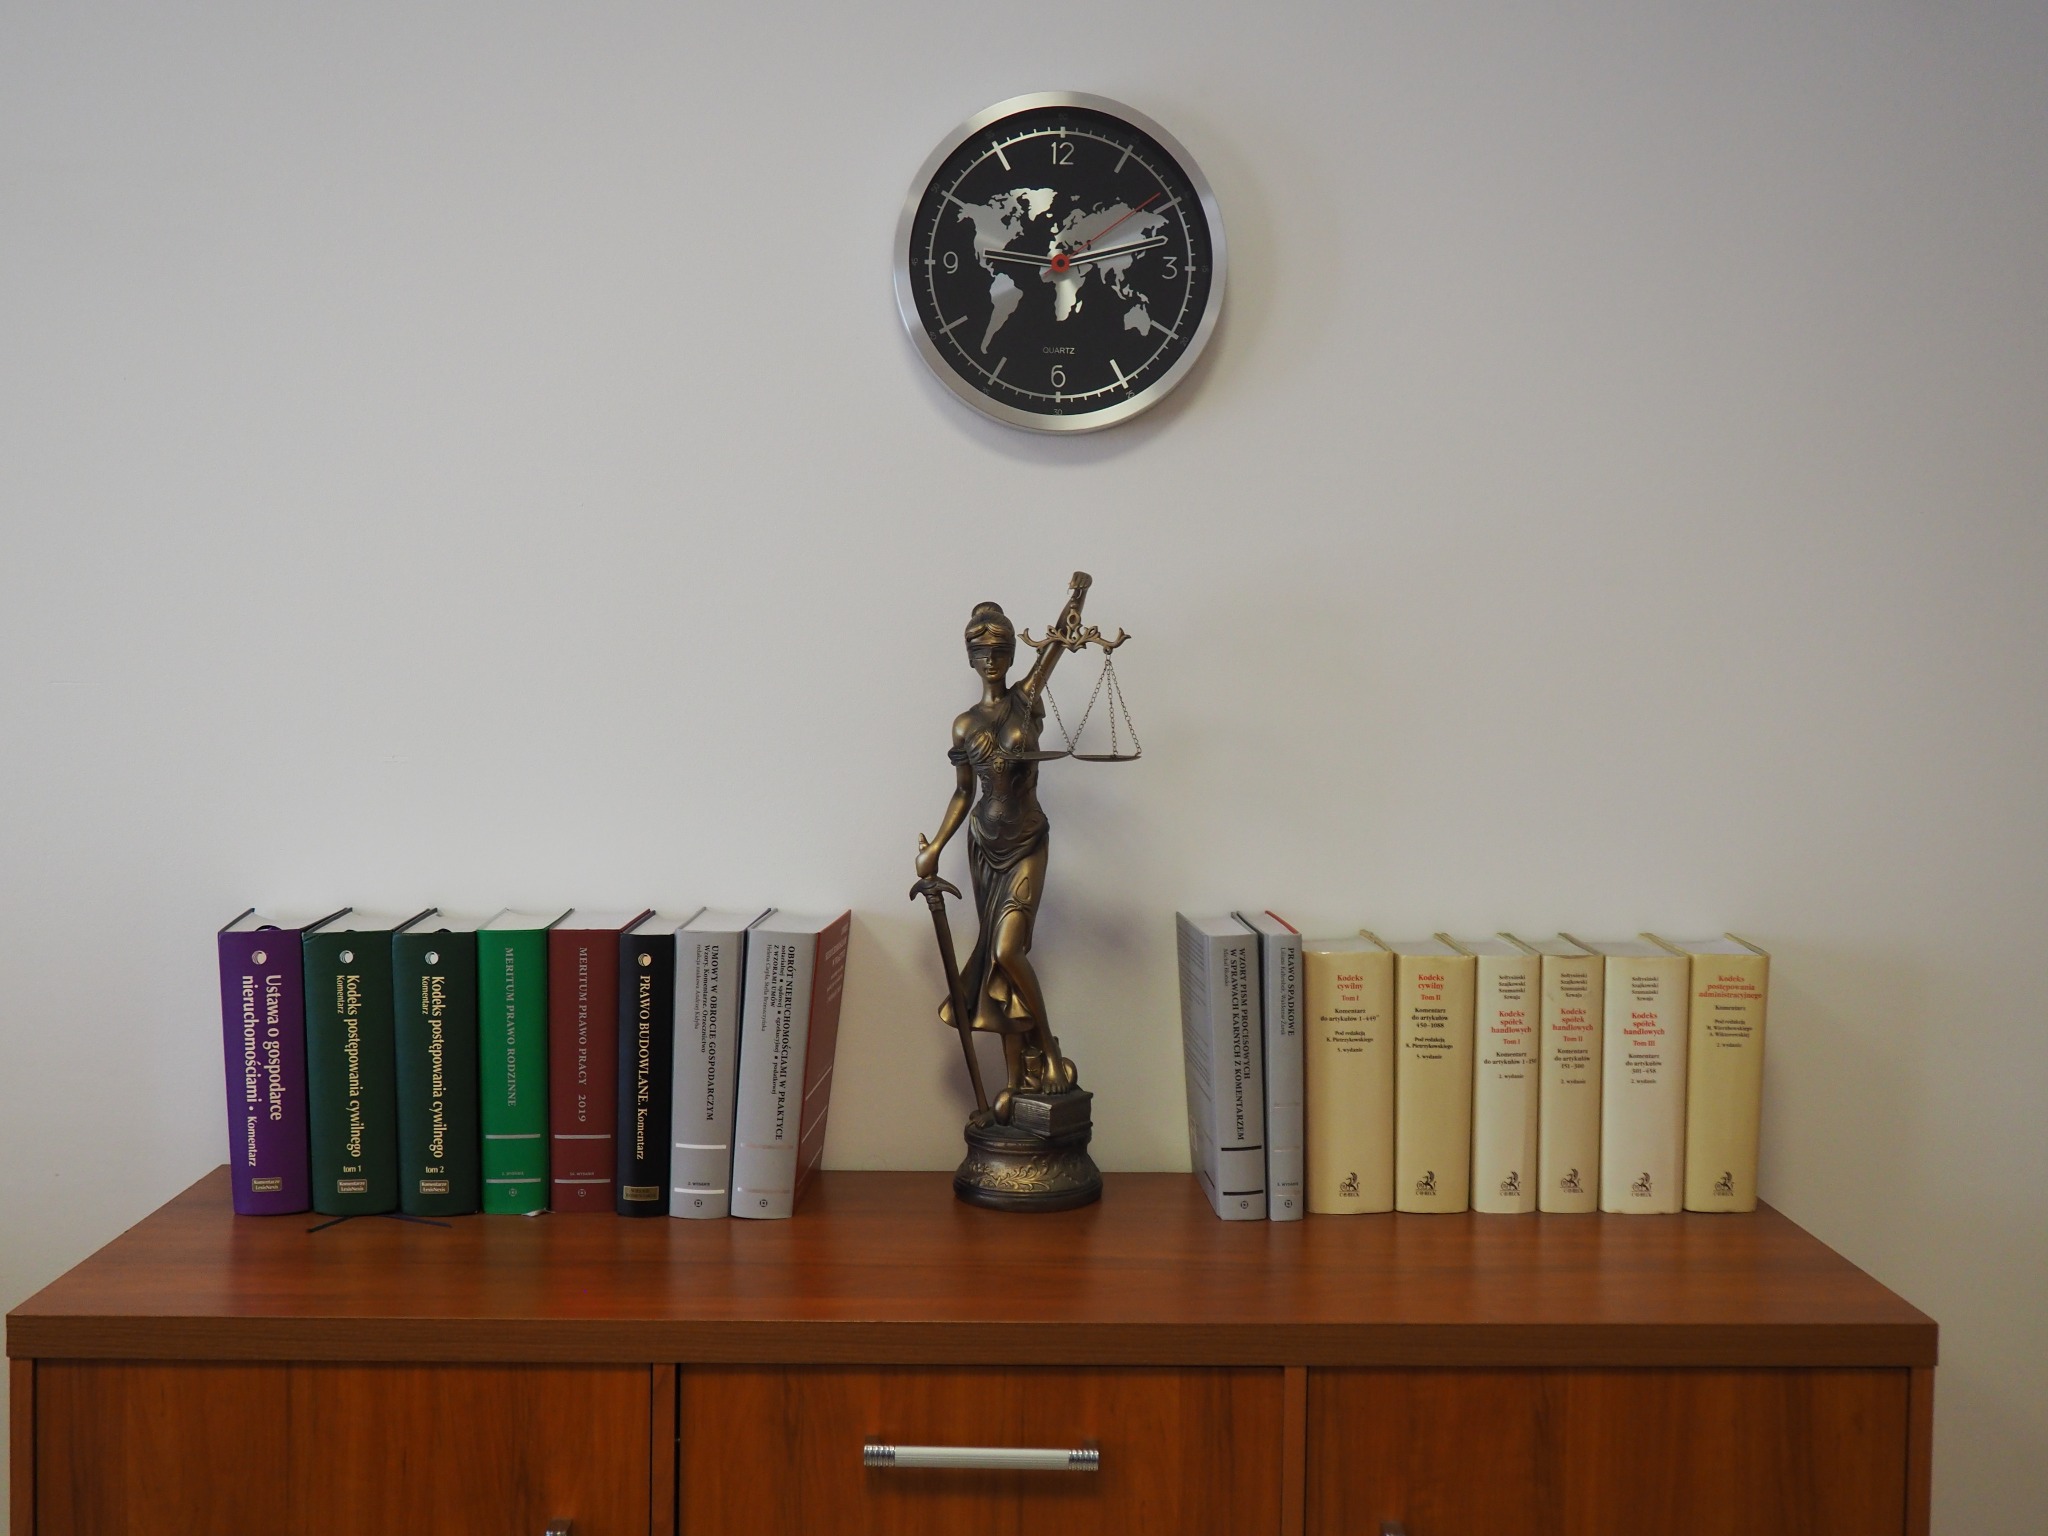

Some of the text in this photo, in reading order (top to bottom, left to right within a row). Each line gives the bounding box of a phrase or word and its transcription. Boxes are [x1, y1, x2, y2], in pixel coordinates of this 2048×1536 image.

[1051, 142, 1074, 165] 12
[943, 252, 958, 274] 9
[1162, 256, 1177, 279] 3
[1043, 346, 1075, 355] QUARTZ
[1051, 365, 1066, 387] 6
[1230, 949, 1237, 957] W
[336, 975, 345, 1014] Komentarz
[421, 976, 430, 1014] Komentarz
[1231, 960, 1239, 1010] SPRAWACH
[1337, 983, 1363, 991] cywilny
[1699, 992, 1762, 1000] administracyjnego
[1707, 984, 1755, 992] postępowania
[505, 947, 516, 1106] MERITUM PRAWO RODZINNE
[1239, 948, 1250, 1079] WZORY PISM PROCESOWYCH
[1491, 1026, 1531, 1034] handlowych
[1500, 1018, 1523, 1027] spółek
[1552, 1024, 1593, 1032] handlowych
[1562, 1016, 1584, 1024] spółek
[1624, 1028, 1665, 1036] handlowych
[263, 974, 285, 1120] Ustawa o gospodarce
[578, 947, 588, 1122] MERITUM PRAWO PRACY 2019
[706, 946, 719, 1121] UMOWY W OBROCIE GOSPODARCZYM
[774, 1017, 782, 1053] egzekucyjnej
[775, 946, 796, 1140] OBRÓT NIERUCHOMOŚCIAMI W PRAKTYCE
[1233, 1013, 1241, 1058] KARNYCH
[242, 975, 261, 1166] nieruchomościami Komentarz
[344, 975, 366, 1157] Kodeks postępowania cywilnego
[429, 976, 450, 1158] Kodeks postępowania cywilnego
[636, 975, 650, 1159] PRAWO BUDOWLANE. Komentarz
[1235, 1069, 1244, 1140] KOMENTARZEM
